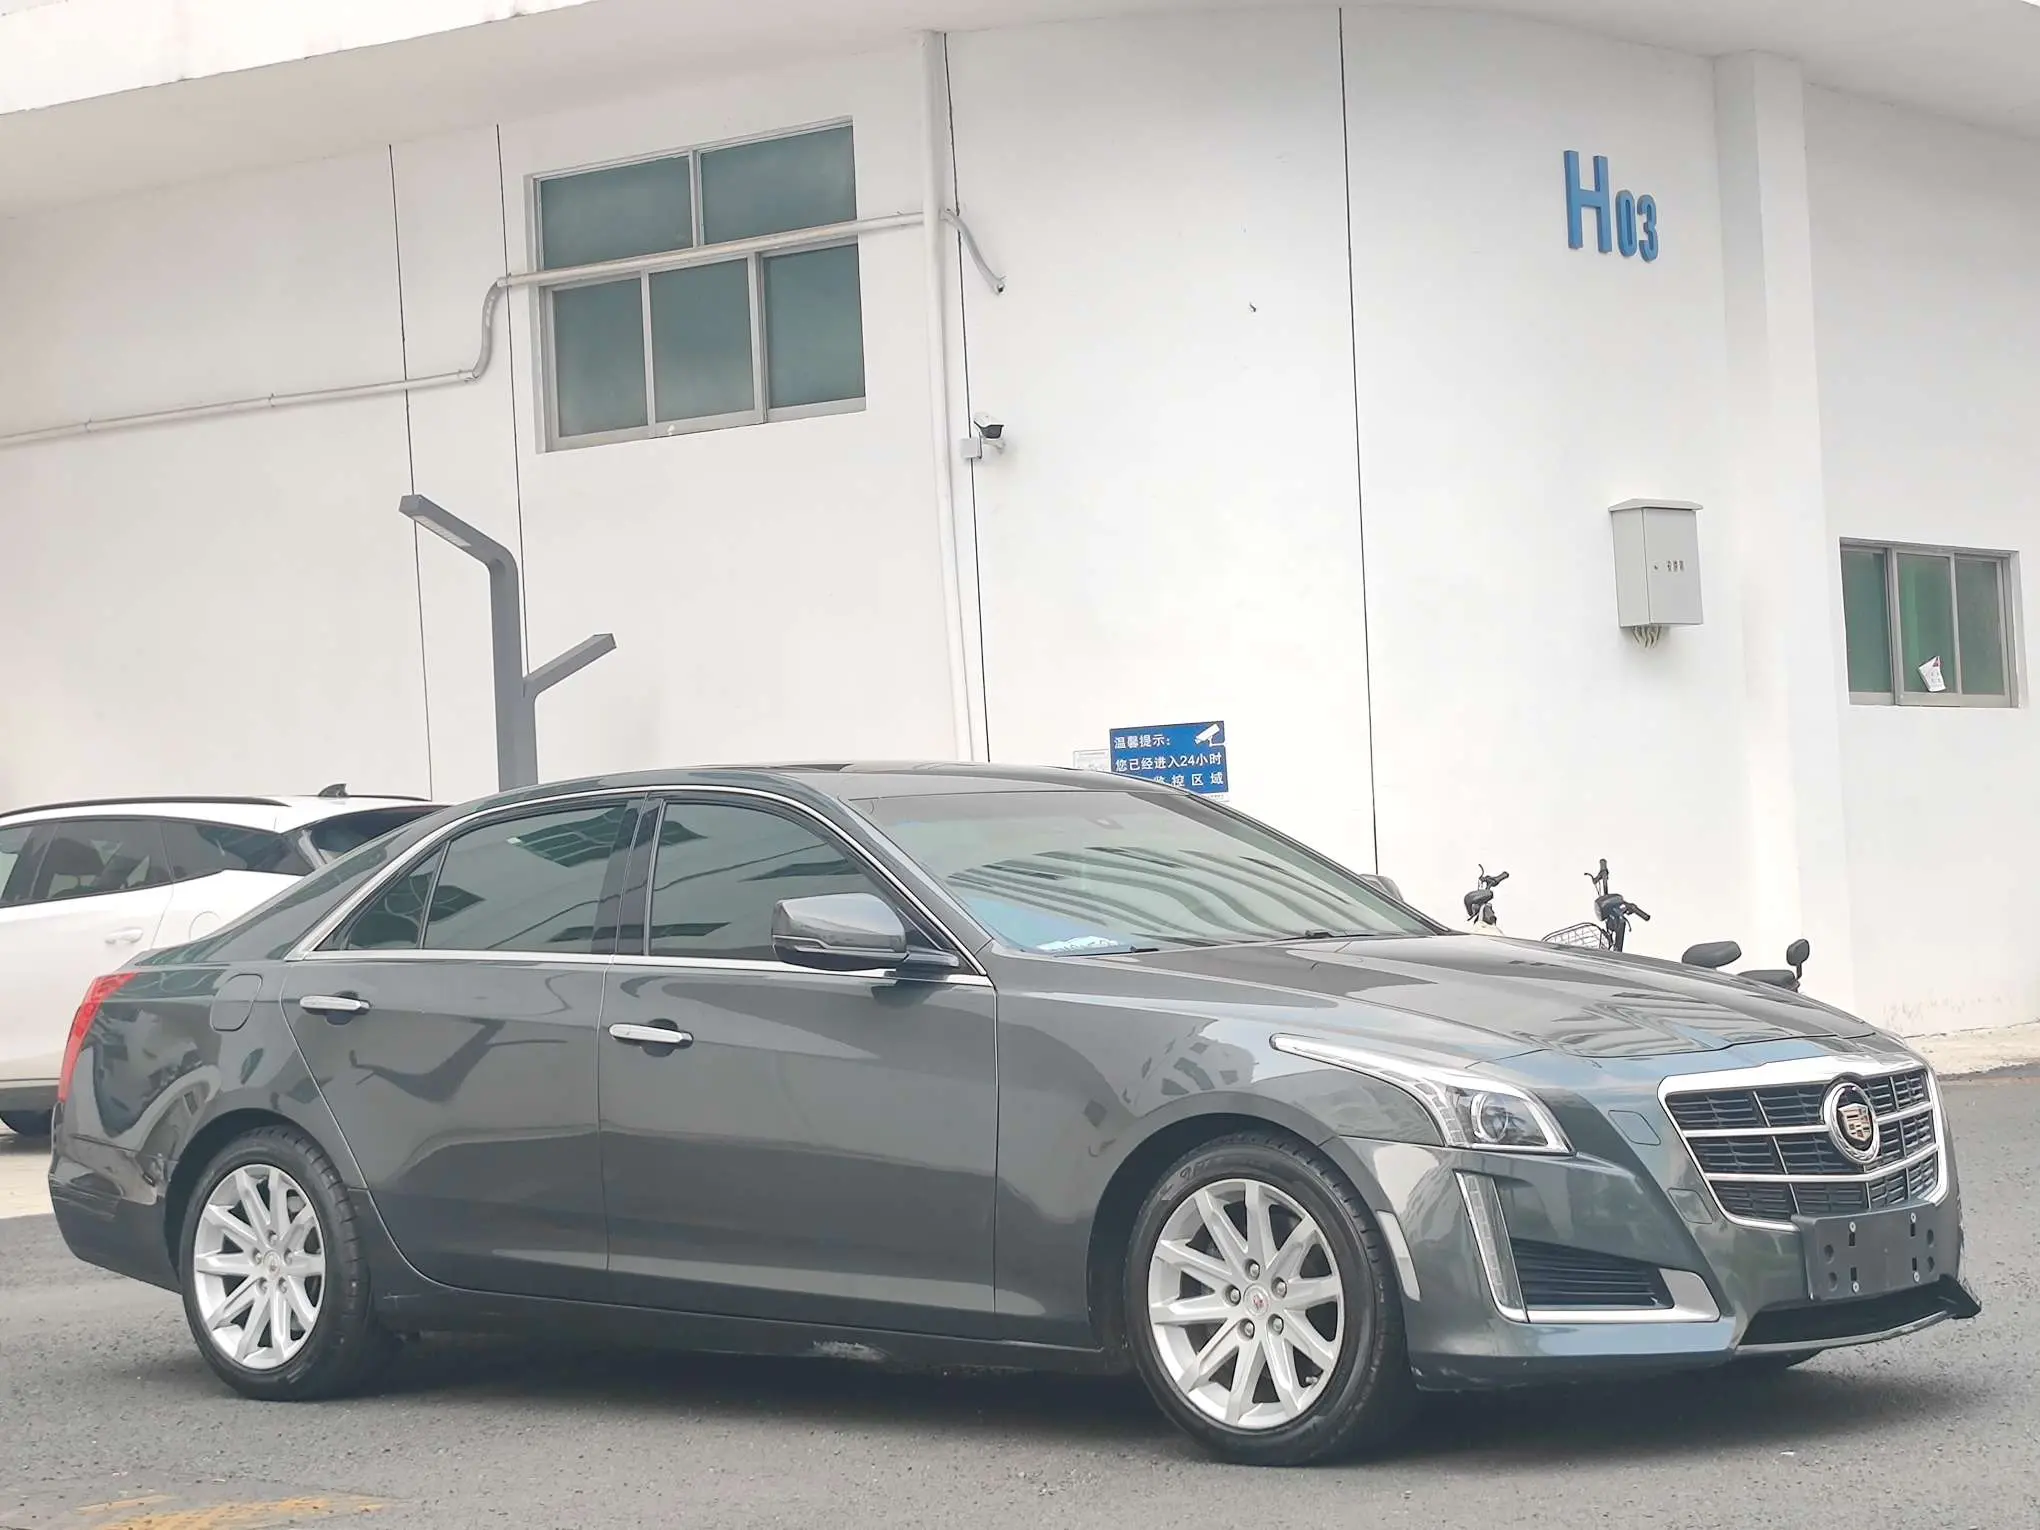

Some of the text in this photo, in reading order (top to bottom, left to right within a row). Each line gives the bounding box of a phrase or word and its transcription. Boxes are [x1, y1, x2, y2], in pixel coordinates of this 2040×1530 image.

[1564, 150, 1658, 263] H03
[1114, 734, 1171, 749] 温馨提示：
[1115, 752, 1222, 772] 您已经进入24小时
